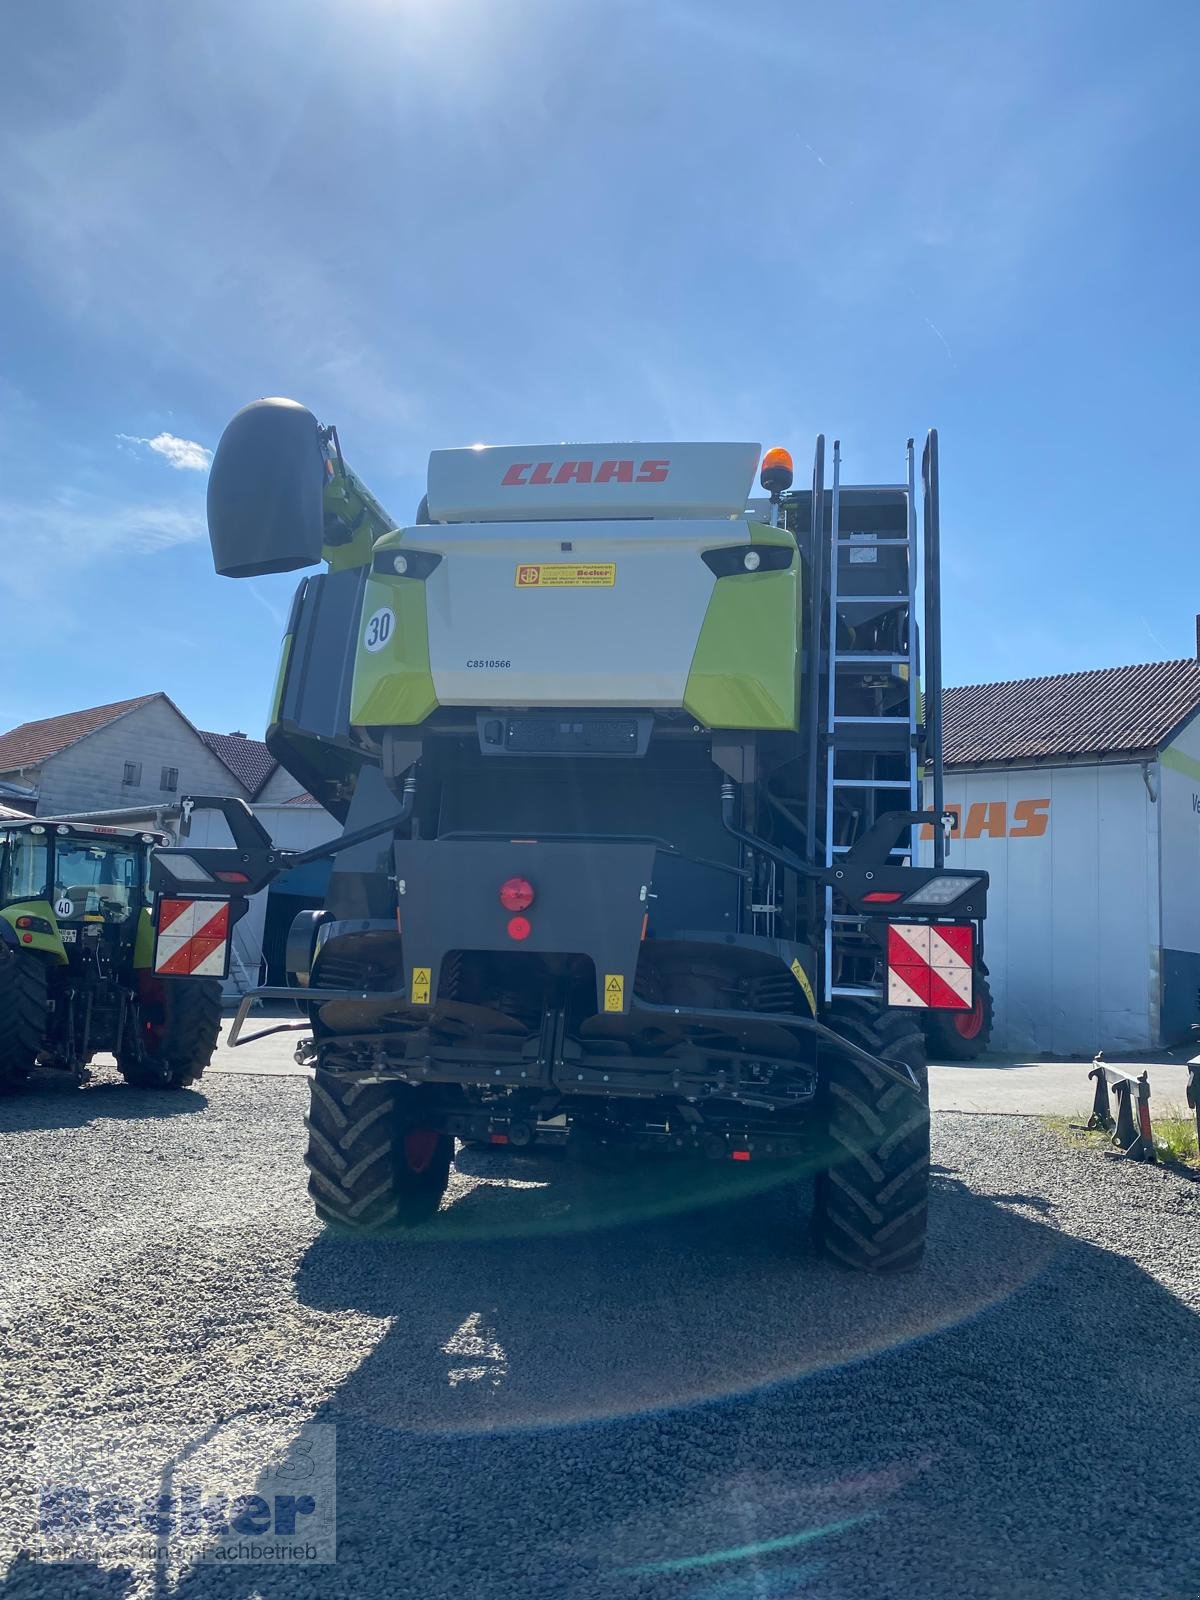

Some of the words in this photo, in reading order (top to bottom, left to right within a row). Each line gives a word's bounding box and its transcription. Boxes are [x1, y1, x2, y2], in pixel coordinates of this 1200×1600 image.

[501, 460, 671, 486] CLAAS
[367, 613, 390, 646] 30
[466, 660, 511, 668] C8510566
[58, 901, 70, 914] 40
